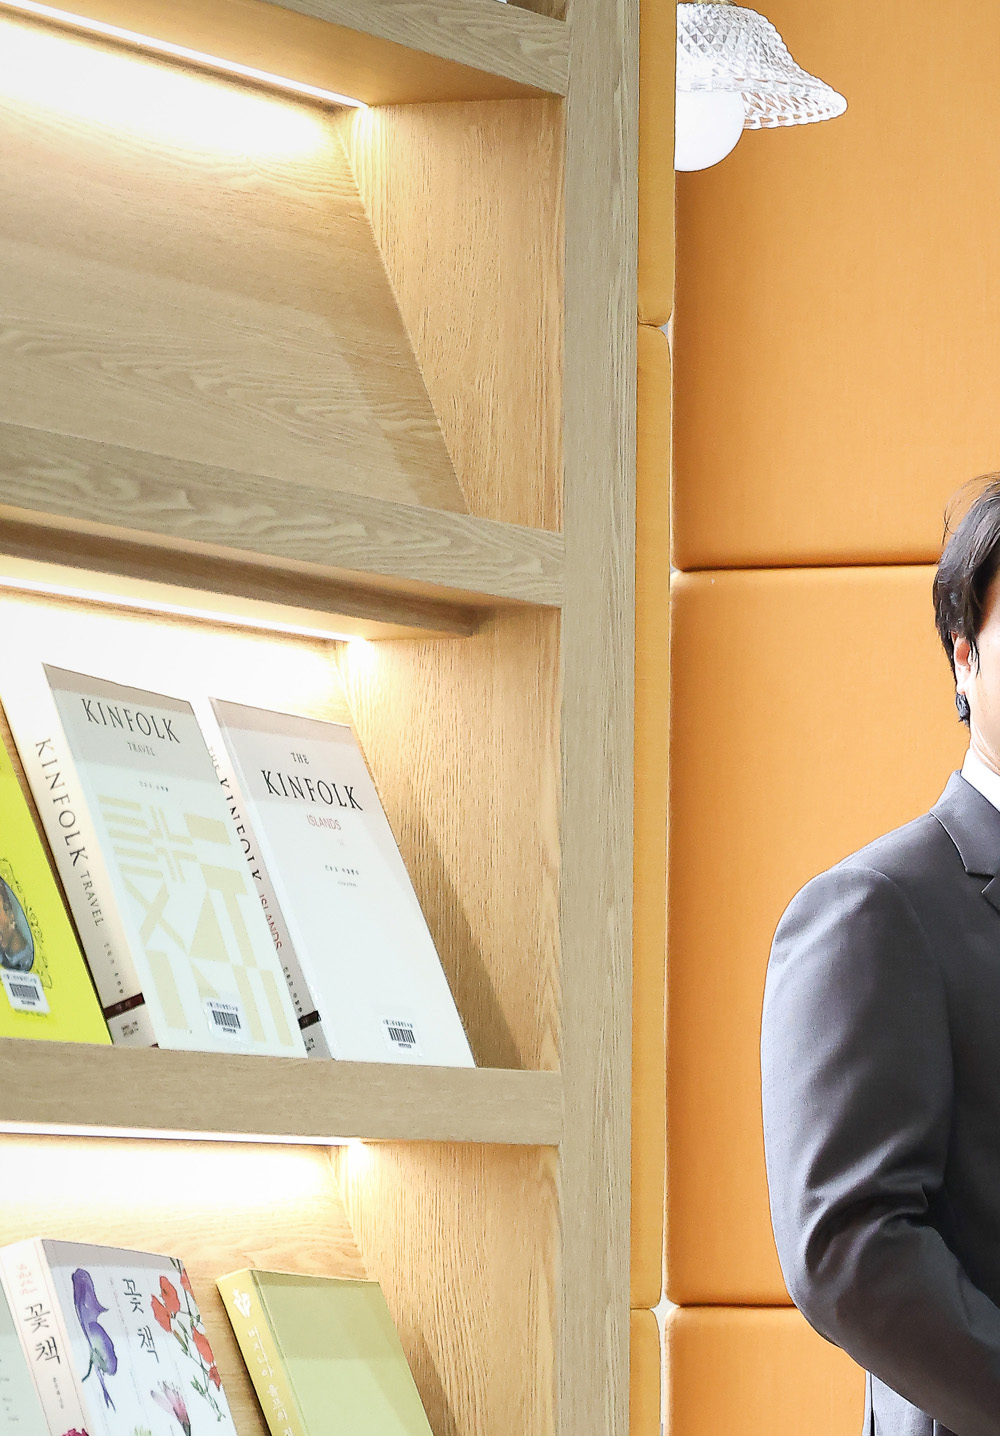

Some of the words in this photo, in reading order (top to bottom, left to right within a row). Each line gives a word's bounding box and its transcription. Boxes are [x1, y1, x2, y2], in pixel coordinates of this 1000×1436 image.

[81, 698, 180, 744] KINFOLK
[127, 741, 155, 757] TRAVEL
[290, 752, 310, 766] THE
[261, 770, 363, 812] KINFOLK
[35, 738, 88, 867] KINFOLK
[80, 870, 104, 927] TRAVEL
[306, 814, 341, 831] ISLANDS
